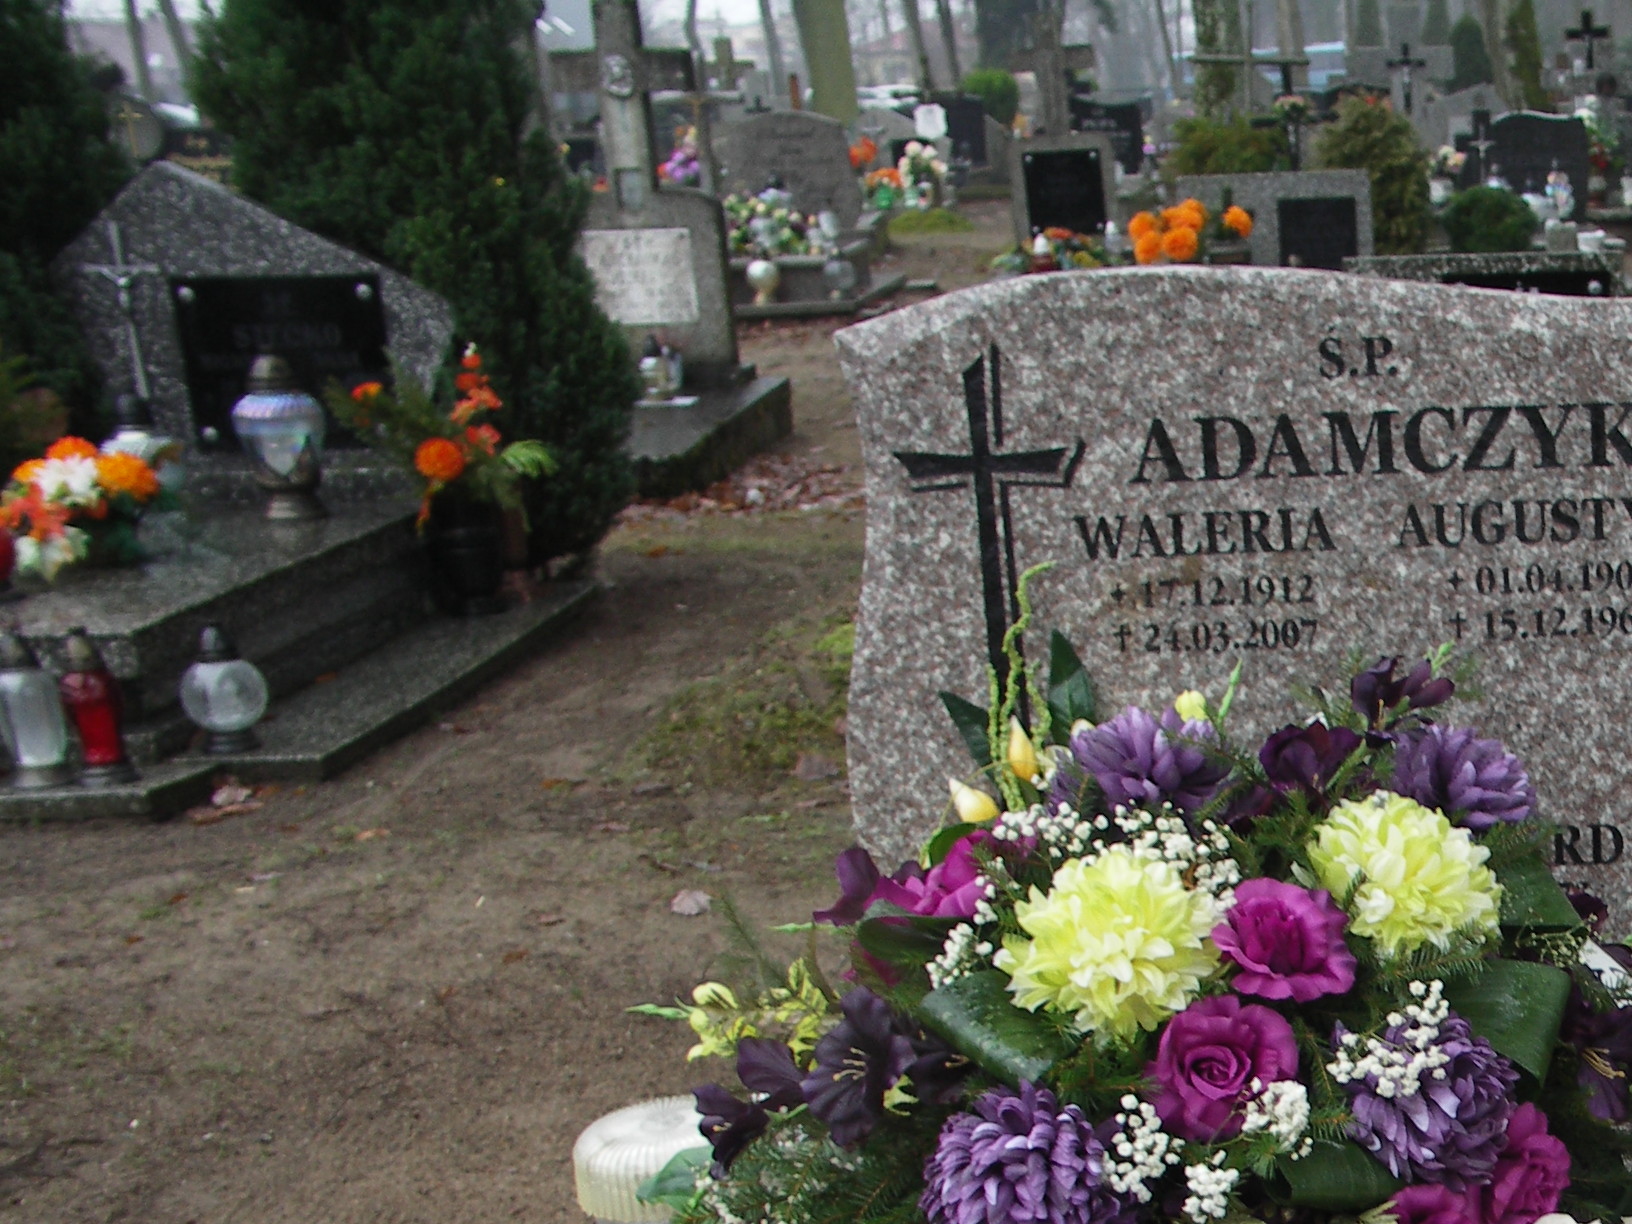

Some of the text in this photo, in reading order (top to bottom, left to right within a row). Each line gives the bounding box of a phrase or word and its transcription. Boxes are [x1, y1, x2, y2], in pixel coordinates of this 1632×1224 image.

[1318, 325, 1399, 380] Ś.P.
[1072, 507, 1338, 561] WALERIA
[1141, 573, 1317, 609] 17.12.1912
[1143, 618, 1318, 653] 24.03.2007
